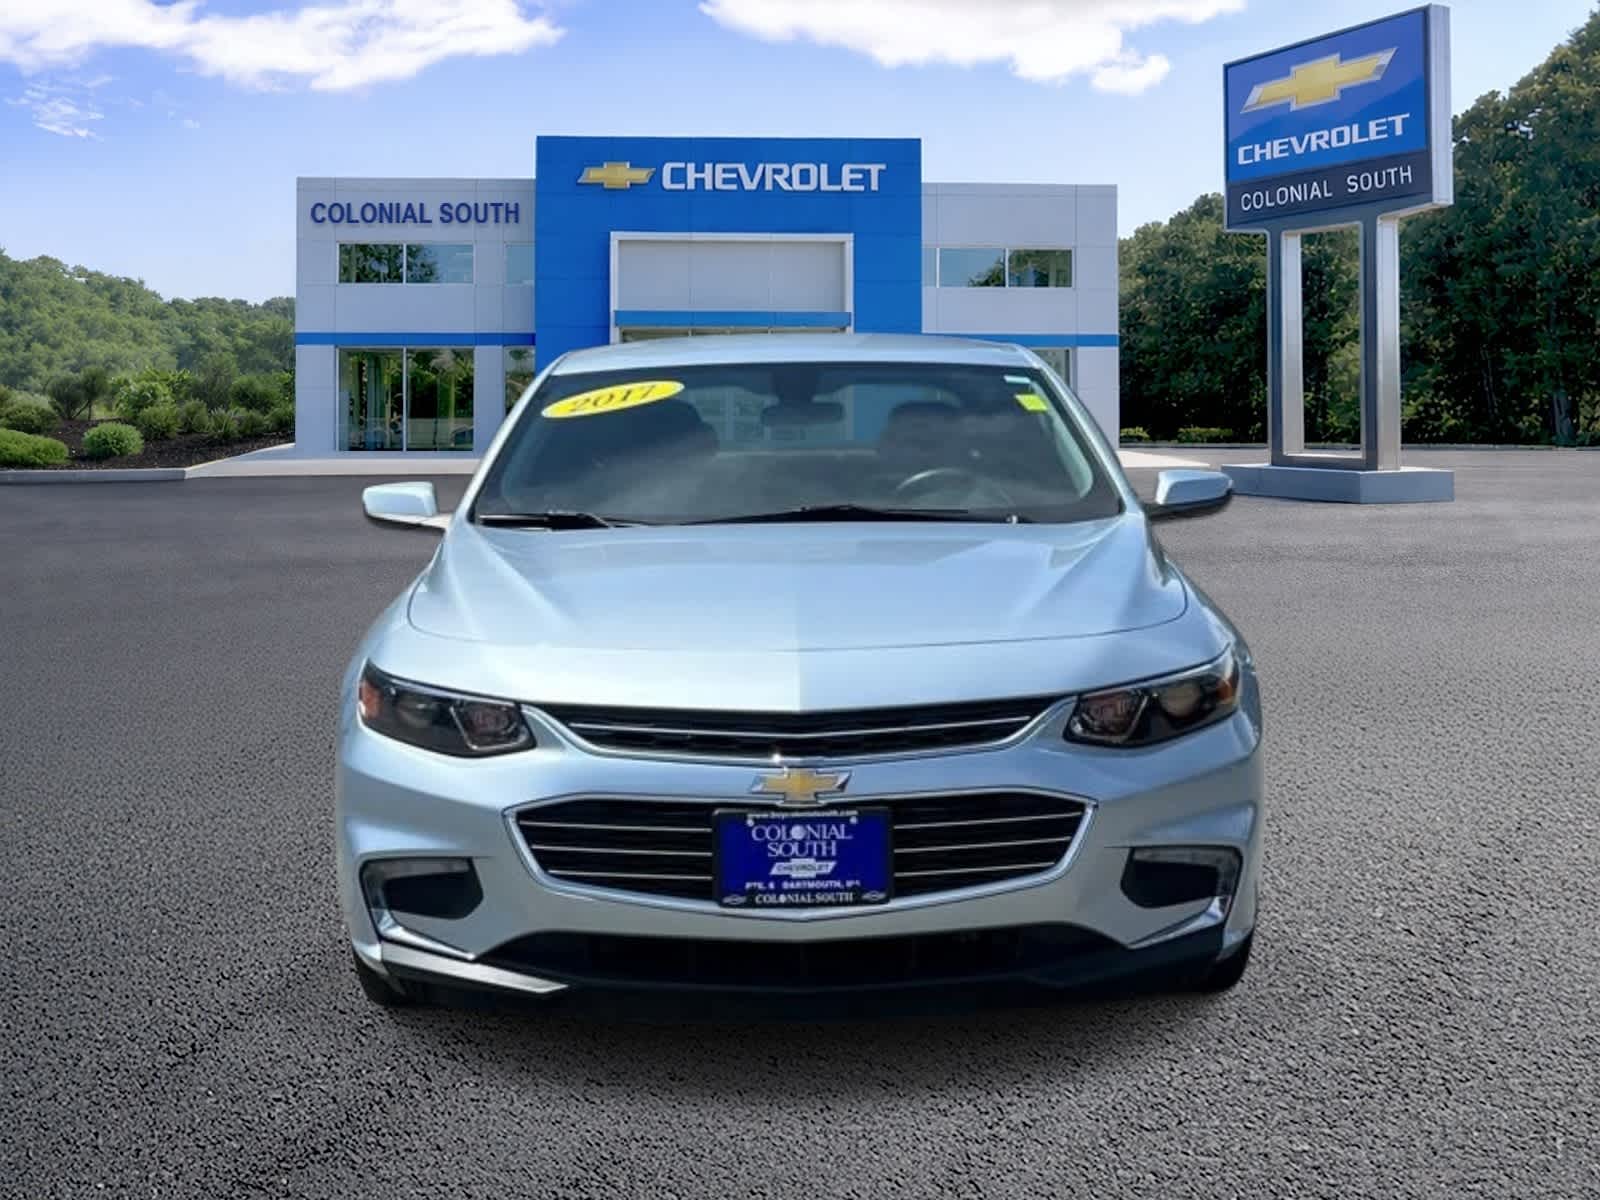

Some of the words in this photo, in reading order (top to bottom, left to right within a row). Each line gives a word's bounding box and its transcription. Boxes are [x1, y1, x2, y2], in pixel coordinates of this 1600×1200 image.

[1237, 112, 1410, 166] CHEVROLET
[661, 162, 887, 192] CHEVROLET
[1240, 179, 1334, 212] COLONIAL
[1346, 164, 1413, 194] SOUTH
[310, 201, 433, 225] COLONIAL
[438, 201, 521, 224] SOUTH
[568, 385, 658, 412] 2017
[751, 824, 853, 841] COLONIAL
[767, 841, 837, 857] SOUTH
[776, 863, 830, 873] CHEVROLET
[755, 893, 814, 905] COLONIAL
[815, 892, 854, 904] SOUTH
